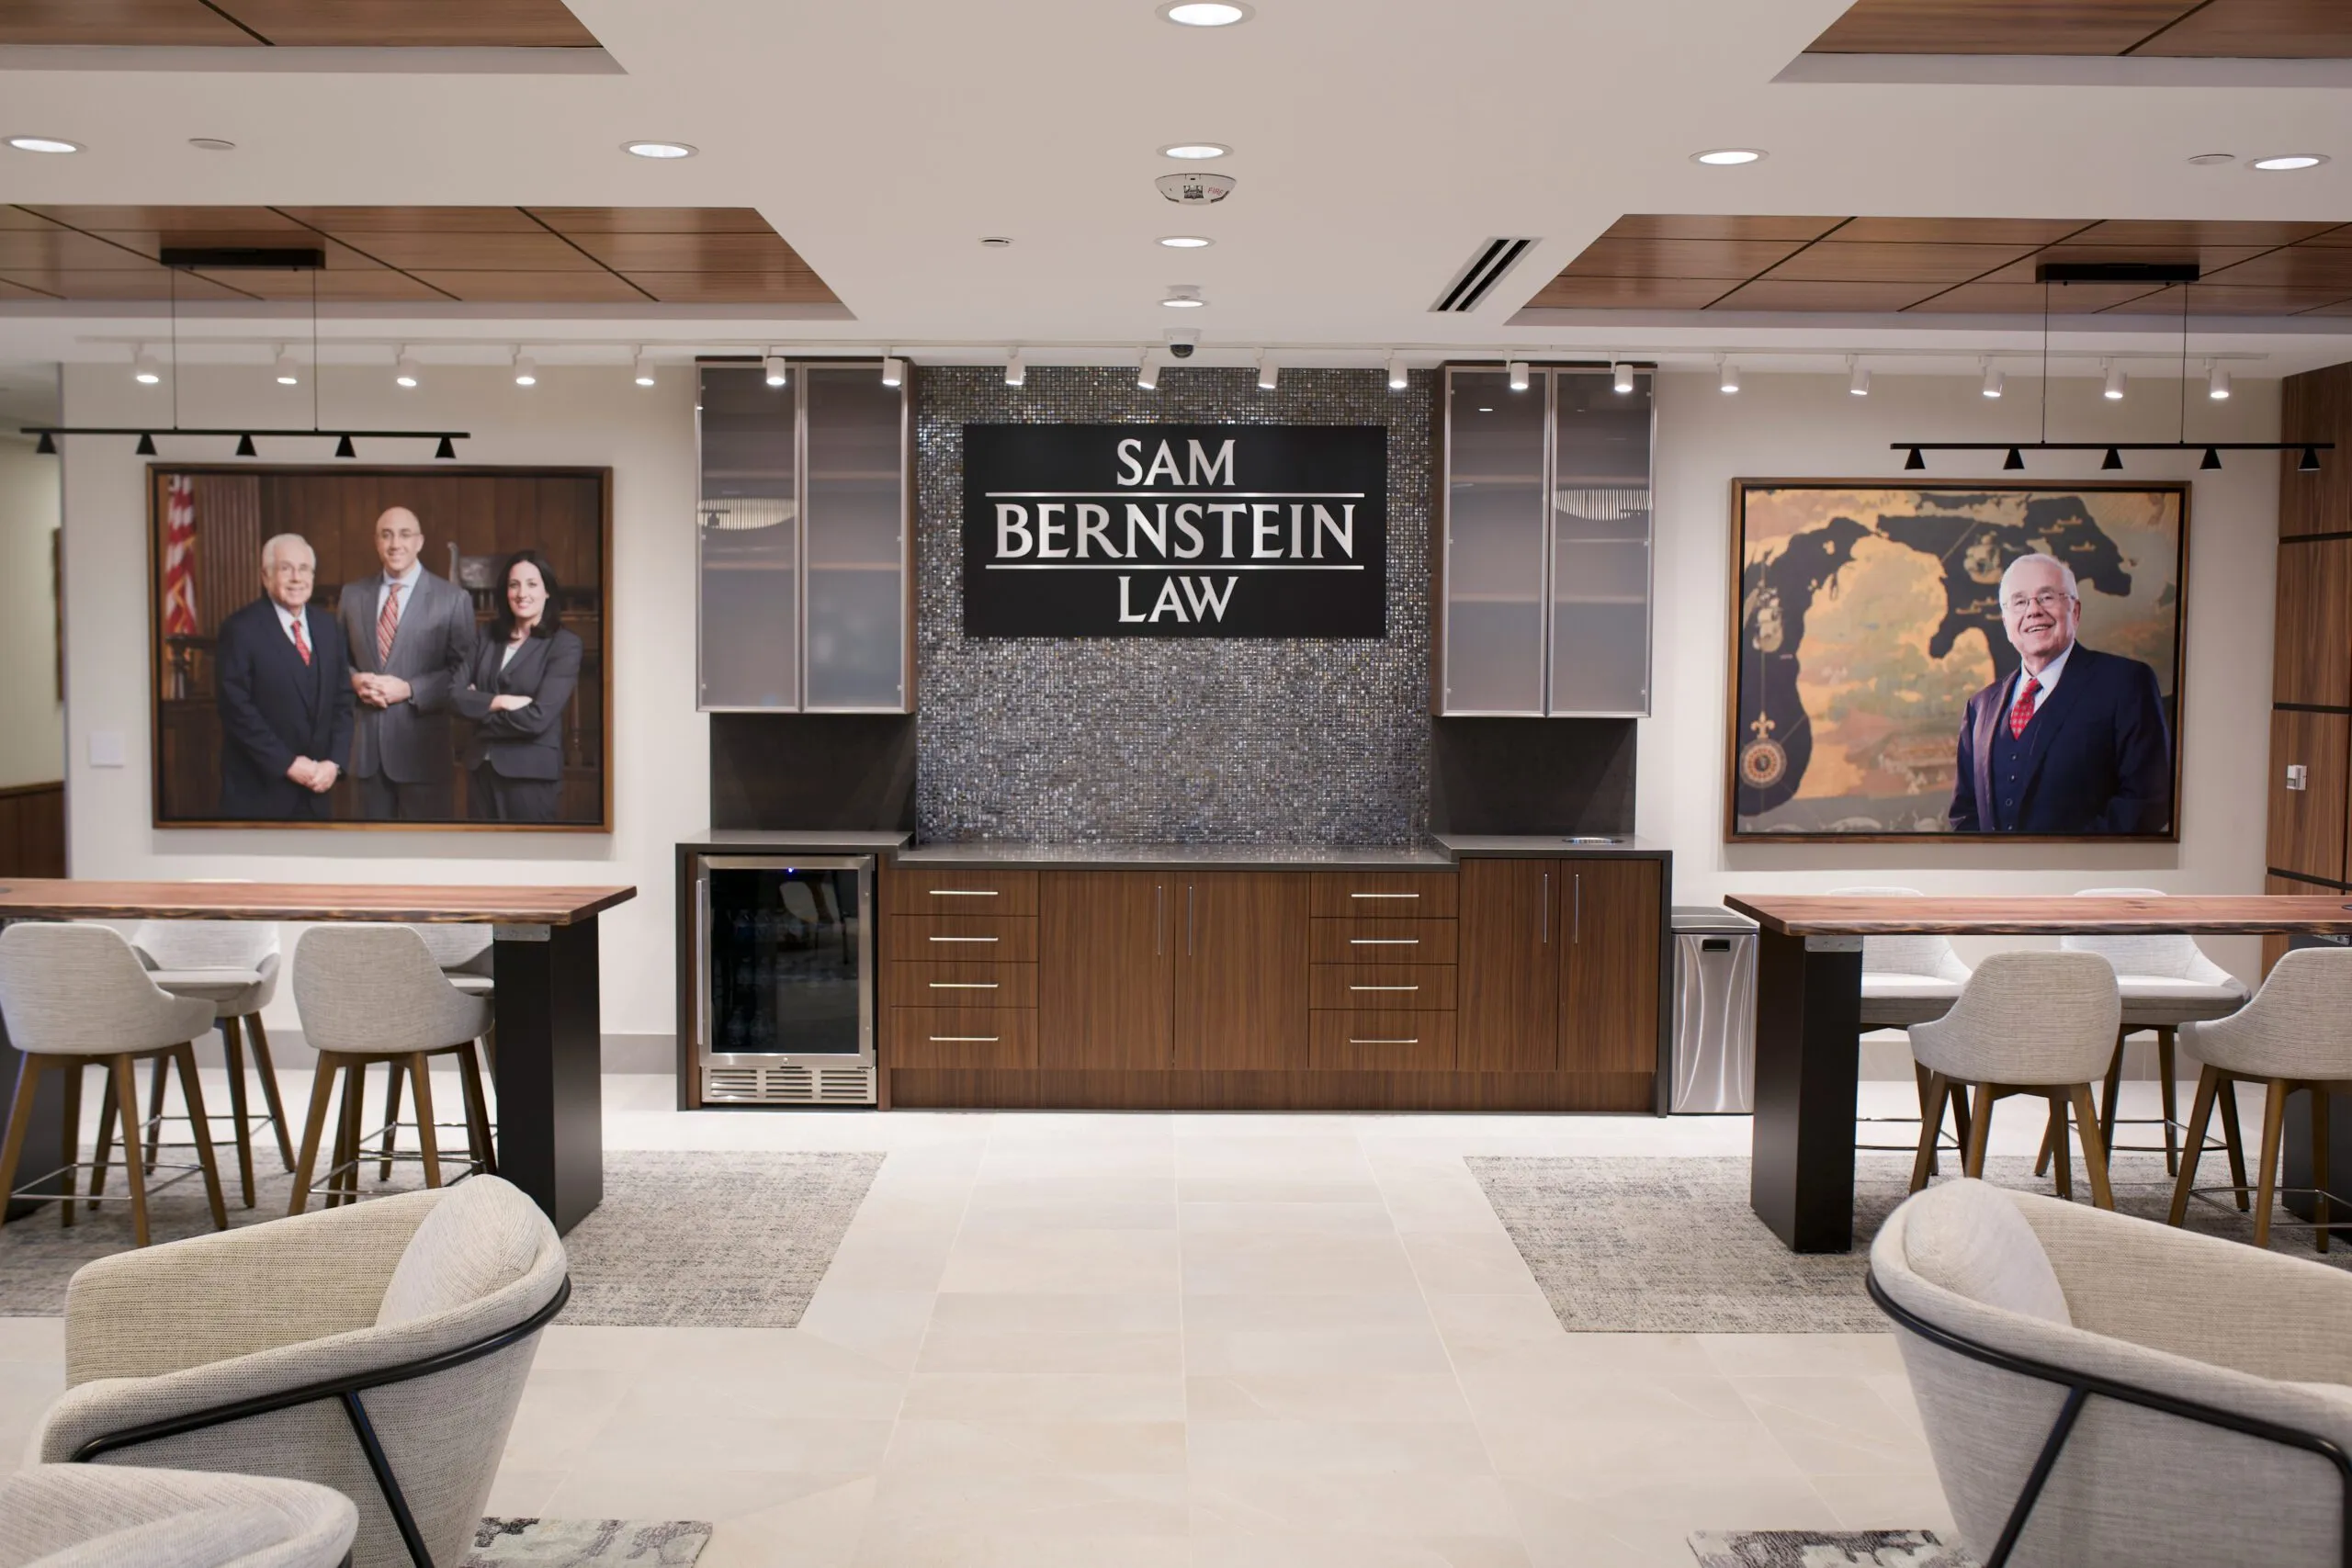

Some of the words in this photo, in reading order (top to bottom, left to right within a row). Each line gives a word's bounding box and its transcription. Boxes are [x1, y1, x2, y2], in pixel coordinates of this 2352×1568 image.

[1116, 438, 1237, 487] SAM
[994, 502, 1356, 559] BERNSTEIN
[1117, 575, 1240, 624] LAW
